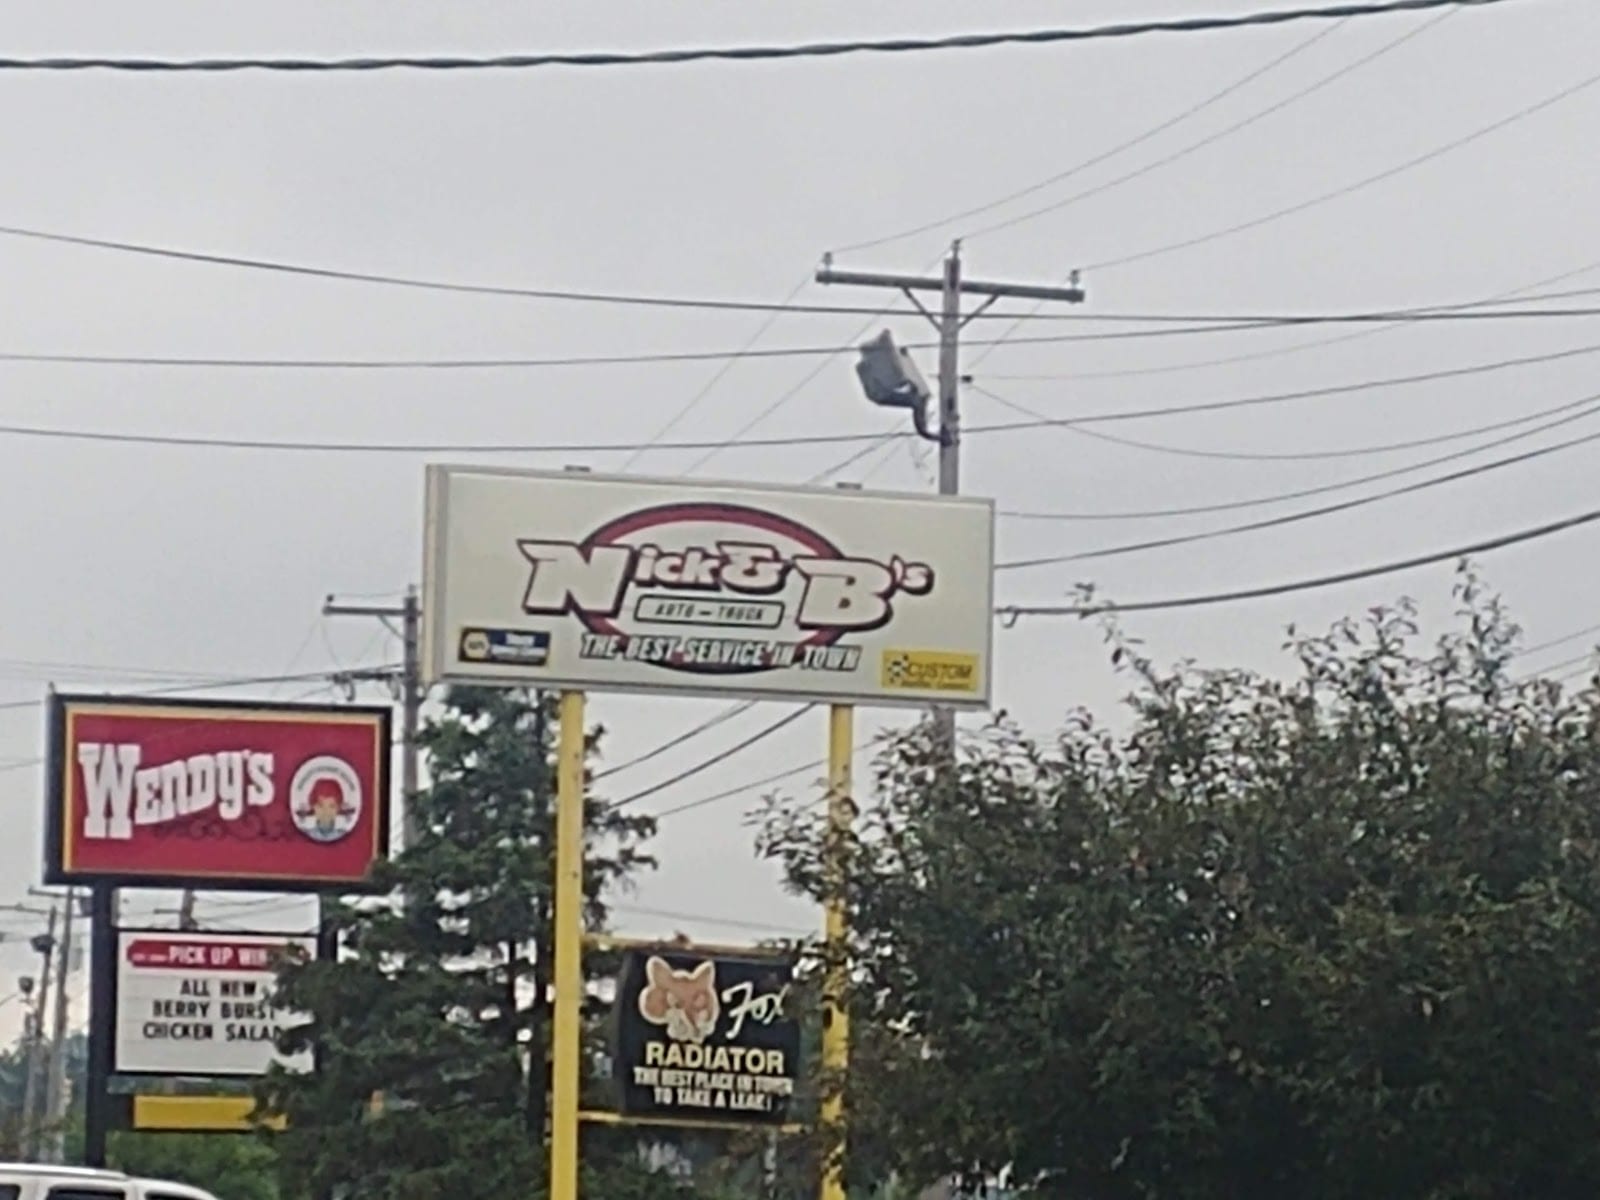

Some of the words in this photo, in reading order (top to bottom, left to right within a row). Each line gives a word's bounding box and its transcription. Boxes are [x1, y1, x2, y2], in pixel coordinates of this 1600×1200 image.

[517, 538, 721, 618] Nick
[792, 554, 935, 632] B's
[655, 603, 695, 618] AUTO
[719, 605, 766, 621] TRUCK
[581, 633, 619, 660] THE
[623, 635, 680, 662] BEST
[682, 638, 766, 667] SERVICE
[771, 642, 796, 669] IN
[799, 645, 863, 672] TOWN
[169, 945, 206, 965] PICK
[210, 946, 234, 966] UP
[180, 979, 210, 997] ALL
[220, 981, 257, 998] NEW
[153, 1001, 210, 1019] BERRY
[220, 1002, 275, 1021] BURST
[721, 981, 791, 1040] Fox
[143, 1022, 213, 1041] CHICKEN
[645, 1041, 784, 1075] RADIATOR
[633, 1066, 659, 1085] THE
[661, 1069, 692, 1087] BEST
[695, 1072, 733, 1090] PLACE
[654, 1086, 673, 1104] TO
[677, 1088, 711, 1107] TAKE
[714, 1091, 727, 1107] A
